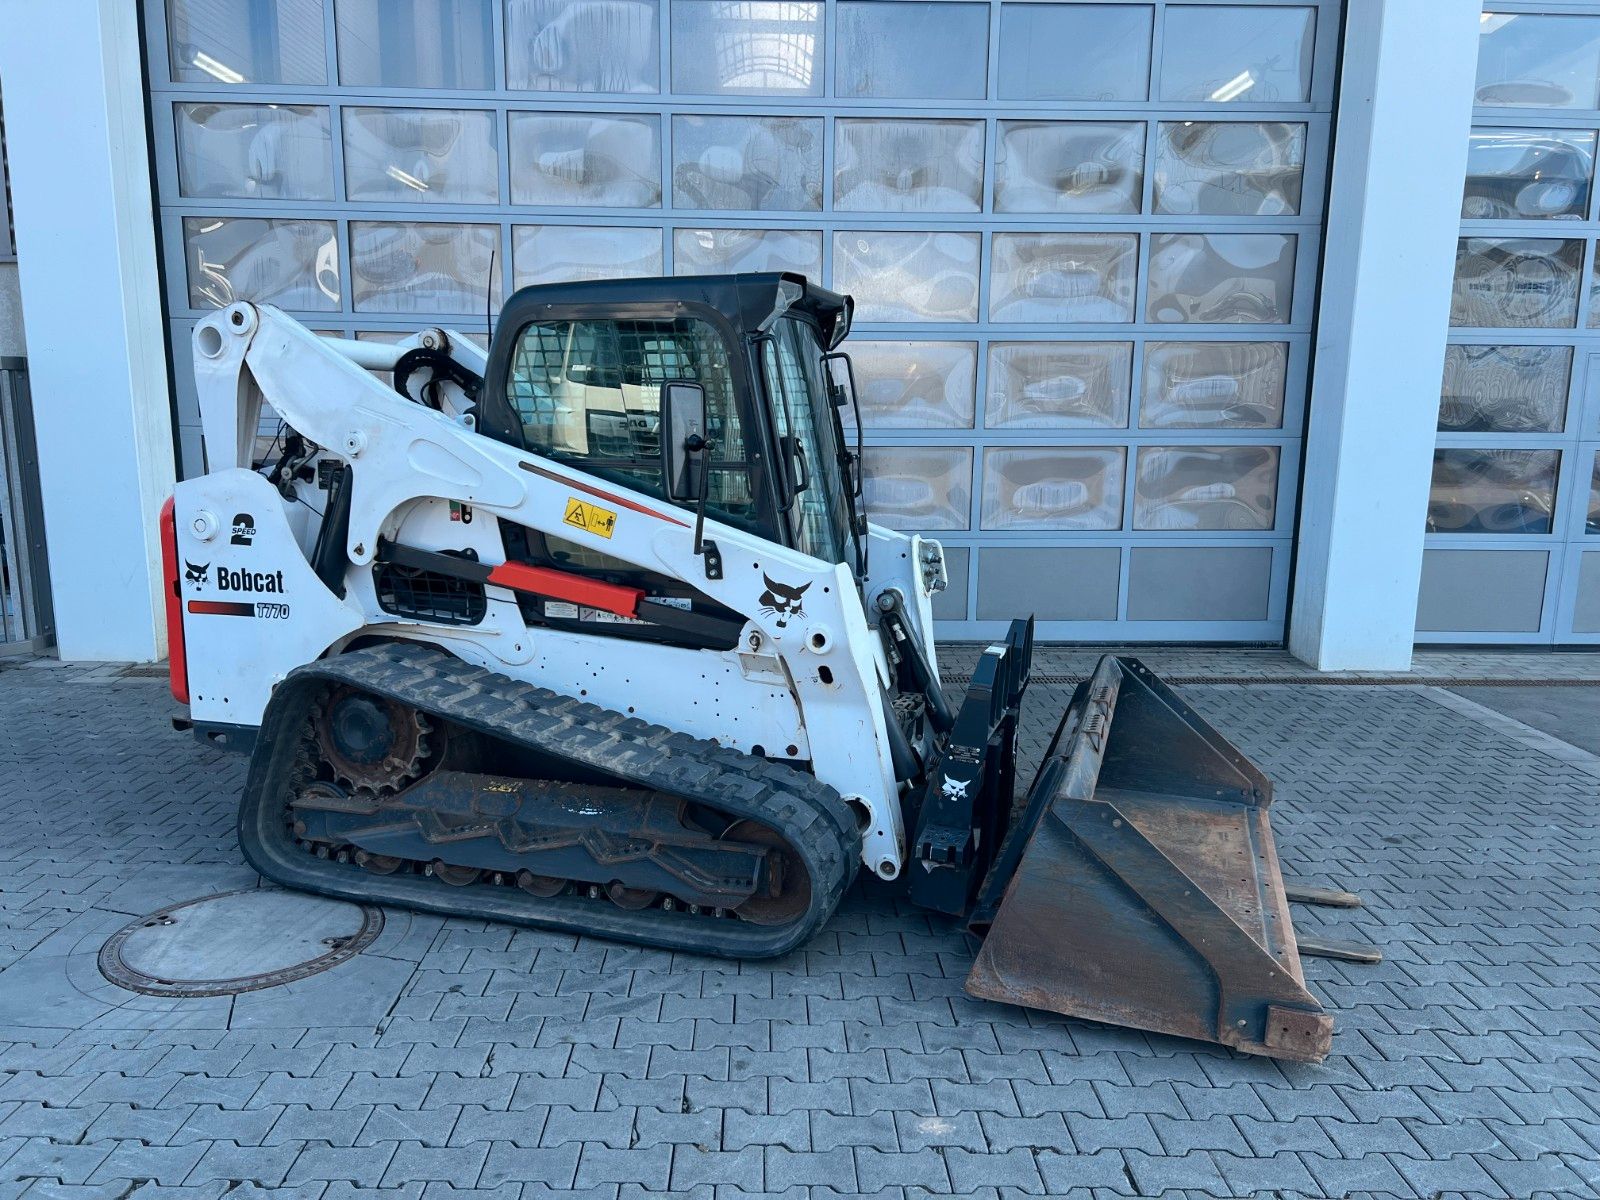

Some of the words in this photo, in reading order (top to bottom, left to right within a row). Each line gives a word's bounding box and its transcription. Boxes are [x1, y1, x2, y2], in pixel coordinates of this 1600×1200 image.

[230, 513, 255, 546] 2
[232, 527, 257, 536] SPEED
[217, 566, 284, 594] Bobcat
[256, 602, 290, 620] T770
